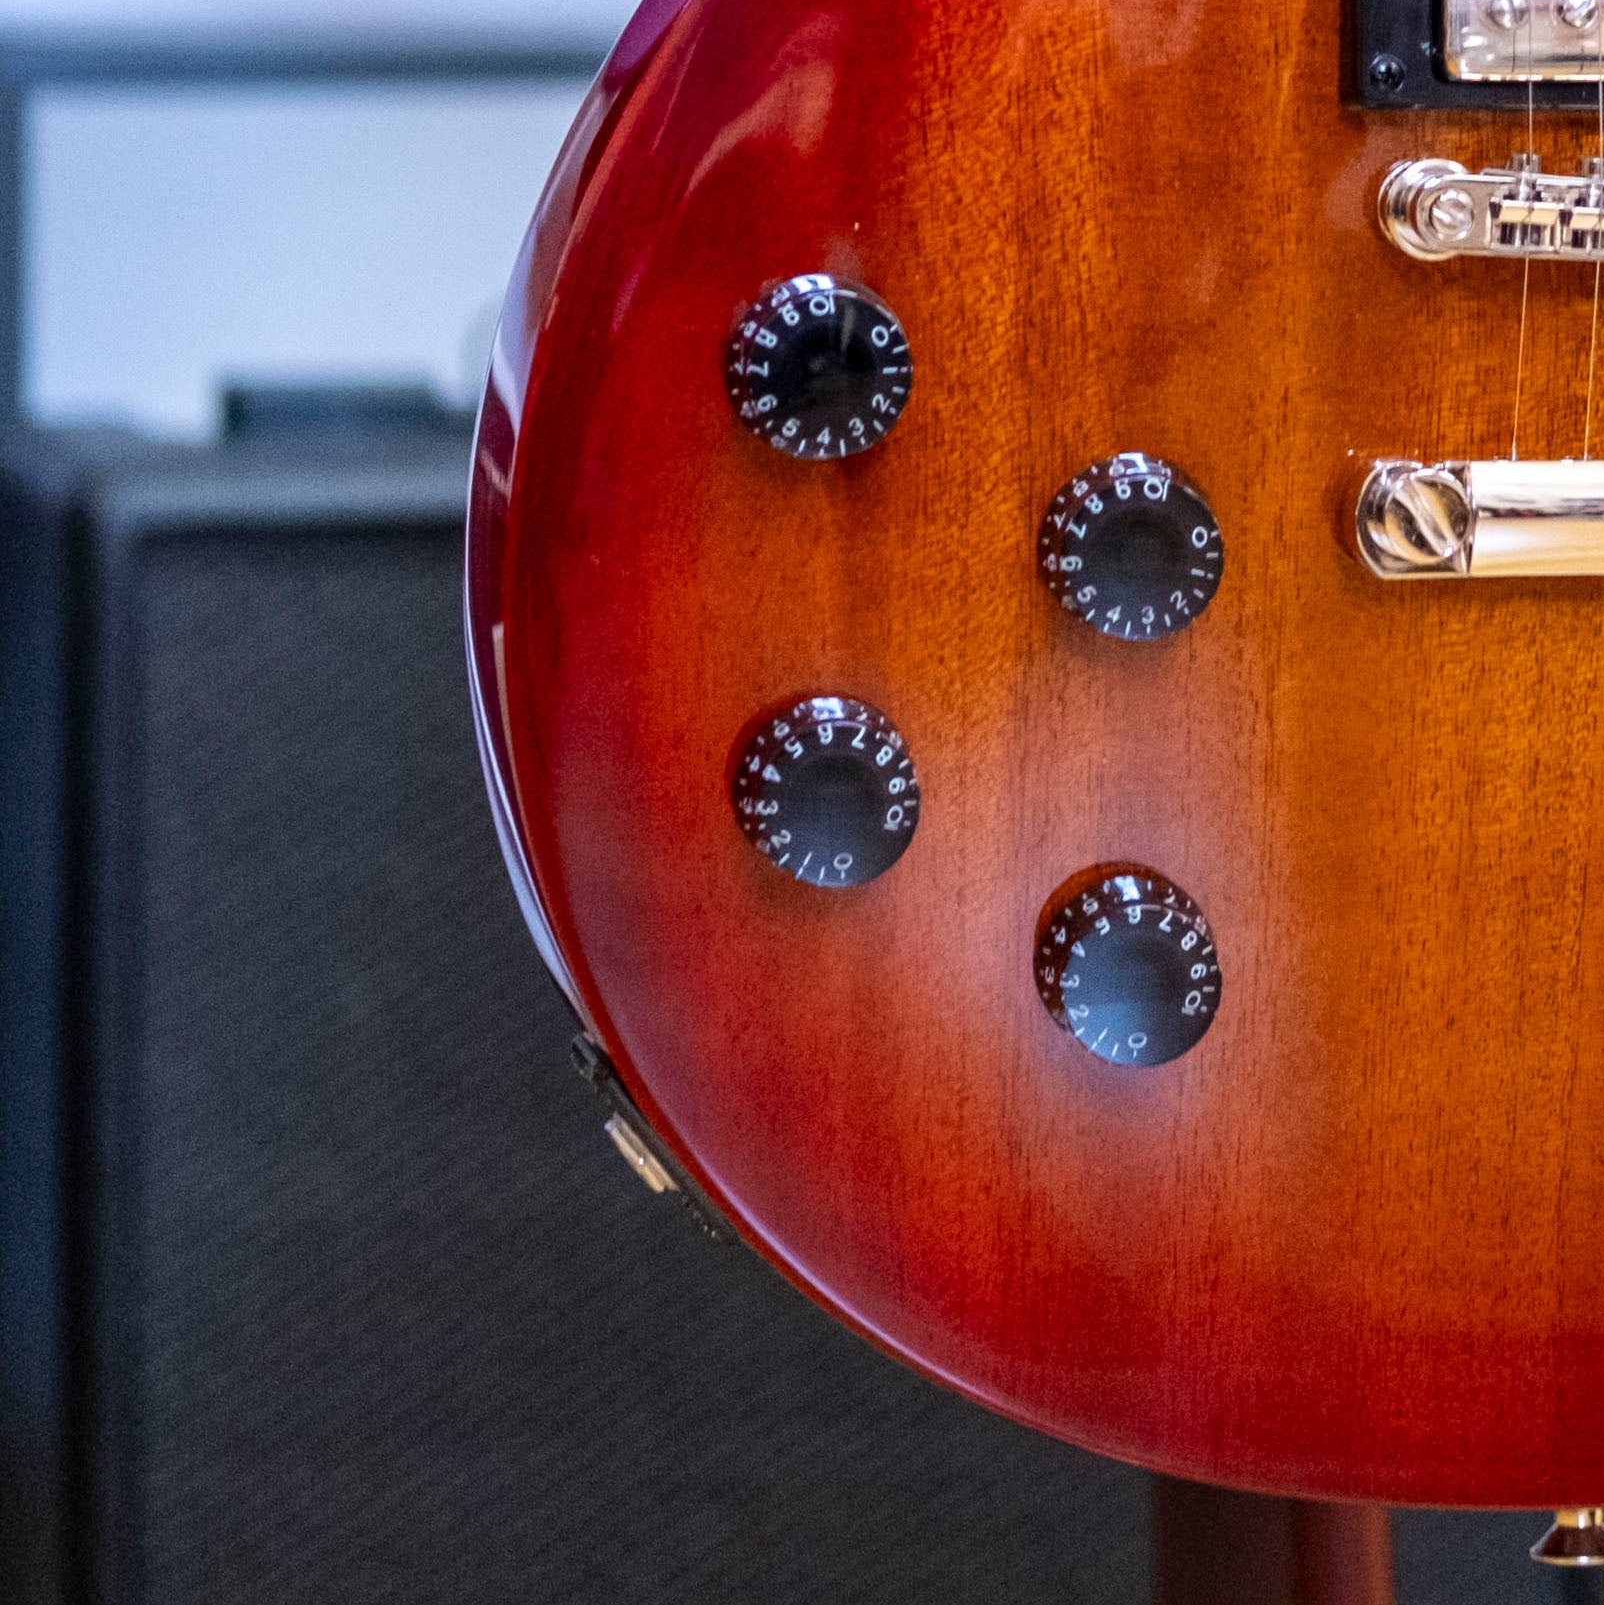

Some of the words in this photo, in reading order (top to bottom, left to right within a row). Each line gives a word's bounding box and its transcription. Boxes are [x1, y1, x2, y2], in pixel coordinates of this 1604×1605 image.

[756, 328, 778, 348] 8
[872, 325, 889, 347] 0
[746, 361, 769, 377] 7
[872, 393, 891, 413] 2
[817, 427, 830, 444] 4
[848, 417, 864, 436] 3
[1085, 494, 1103, 514] 8
[1066, 519, 1087, 539] 7
[1192, 526, 1208, 548] 0
[1170, 591, 1187, 610] 2
[1106, 606, 1121, 623] 4
[1141, 606, 1154, 625] 3
[851, 726, 866, 749] 7
[876, 745, 892, 766] 8
[762, 764, 781, 783] 4
[755, 800, 778, 815] 3
[771, 829, 791, 848] 2
[833, 853, 853, 870] 0
[1159, 911, 1173, 932] 7
[1071, 941, 1085, 957] 4
[1181, 931, 1197, 951] 8
[1060, 973, 1079, 988] 3
[1069, 1005, 1088, 1021] 2
[1128, 1032, 1147, 1048] 0
